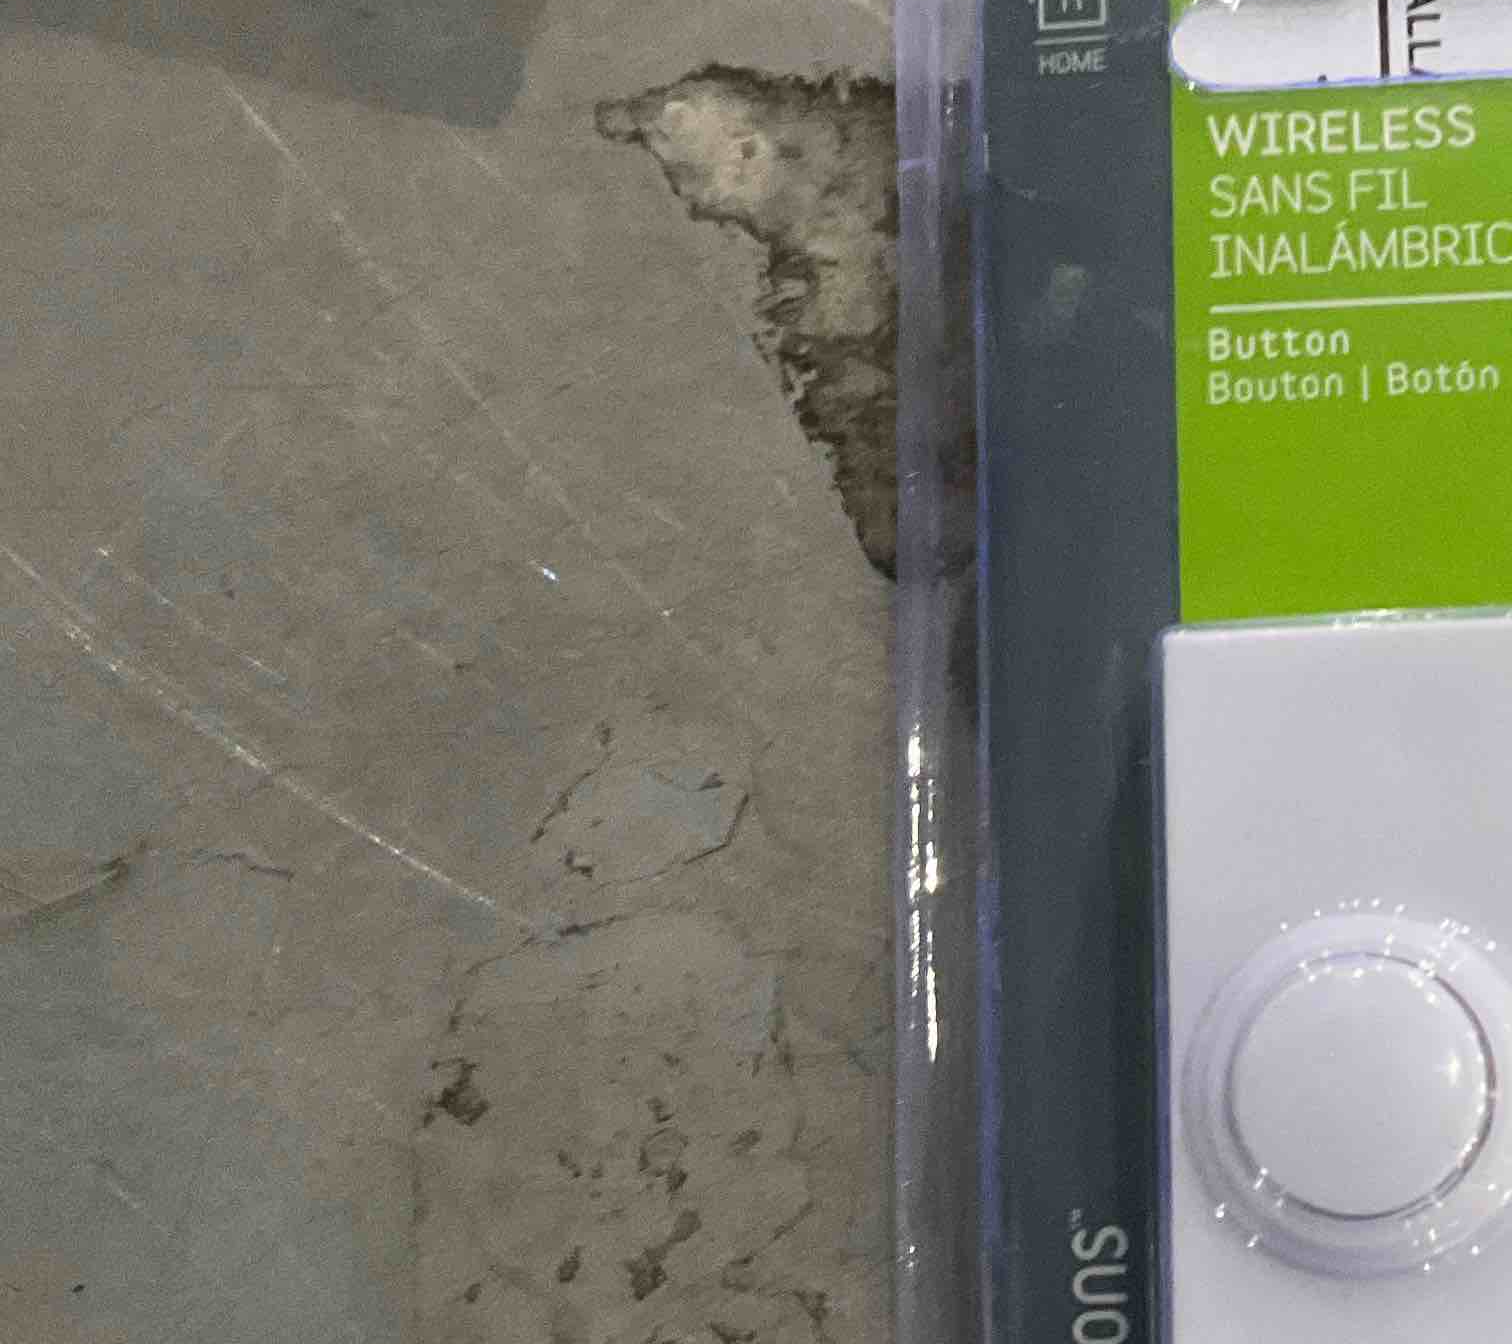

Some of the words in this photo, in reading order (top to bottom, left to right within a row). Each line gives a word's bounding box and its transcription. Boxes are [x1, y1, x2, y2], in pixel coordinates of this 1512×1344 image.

[1039, 47, 1107, 76] HOME
[1207, 104, 1477, 158] WIRELESS
[1209, 170, 1334, 219] SANS
[1349, 167, 1430, 212] FIL
[1208, 327, 1351, 362] Button
[1208, 370, 1344, 405] Bouton
[1386, 360, 1500, 396] Botón
